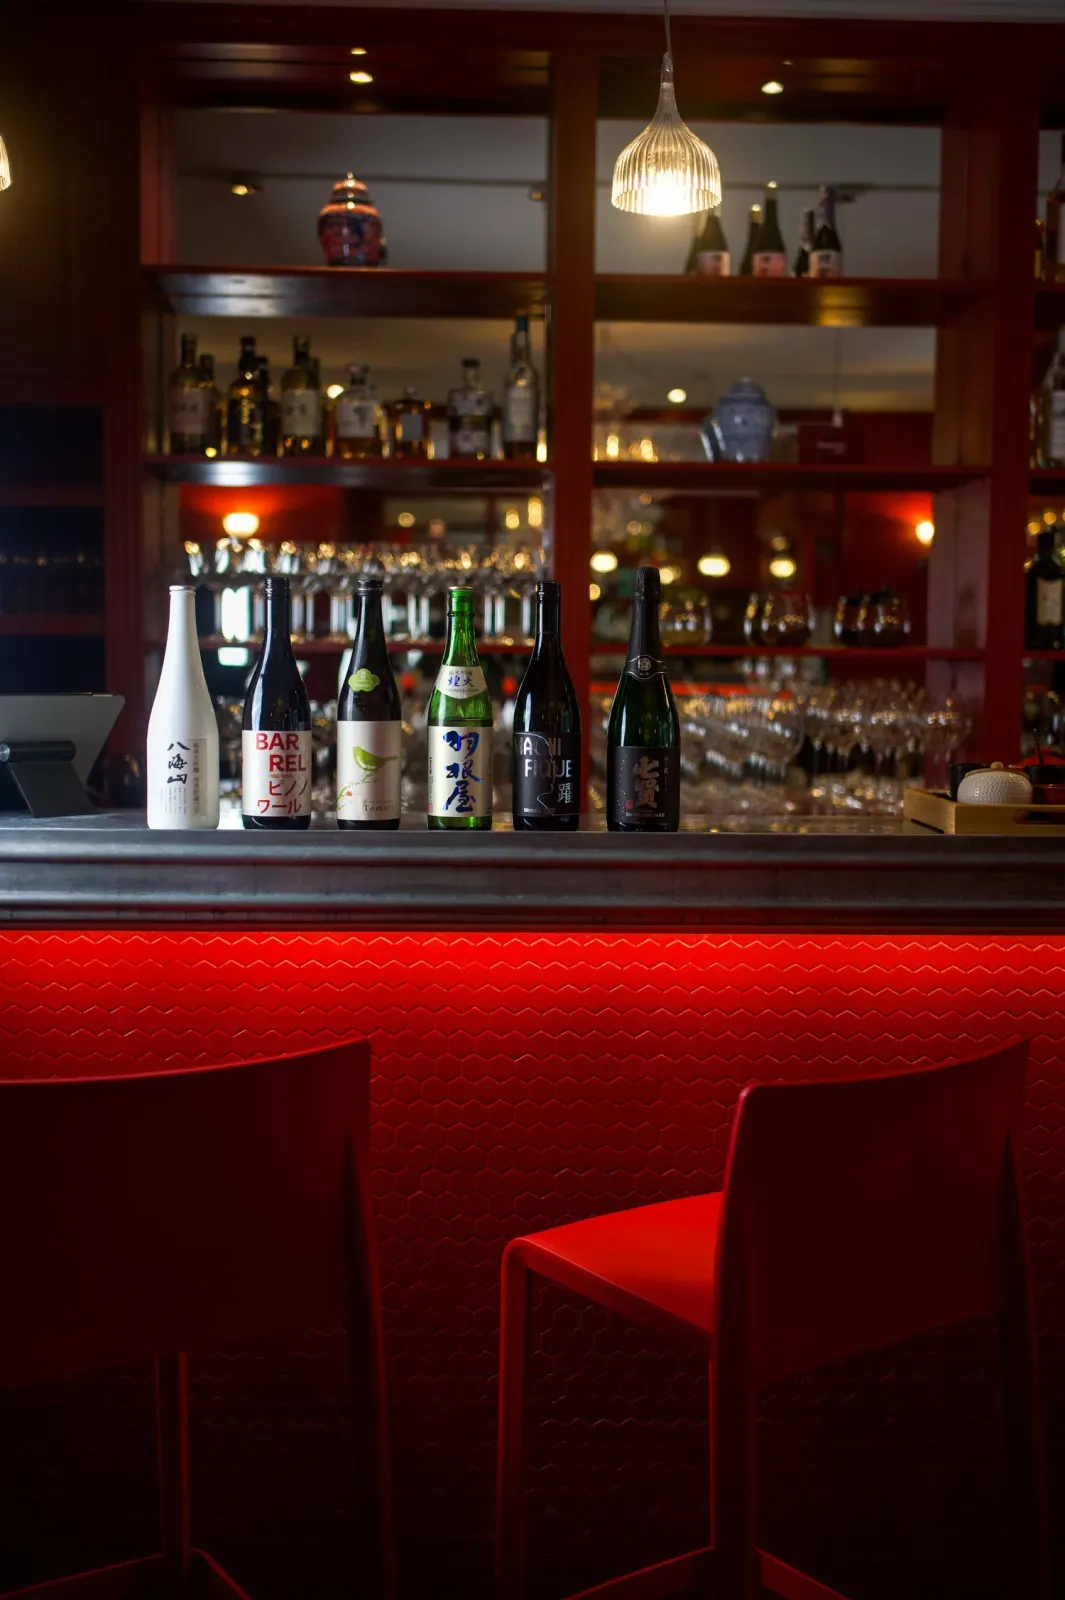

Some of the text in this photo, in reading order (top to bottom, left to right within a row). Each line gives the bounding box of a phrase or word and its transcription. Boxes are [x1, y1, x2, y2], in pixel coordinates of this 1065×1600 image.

[256, 732, 300, 751] BAR
[167, 741, 191, 785] 八海山
[269, 754, 307, 772] REL
[443, 730, 484, 813] 羽根屋
[269, 780, 308, 797] ピノノ
[257, 798, 302, 814] ワール
